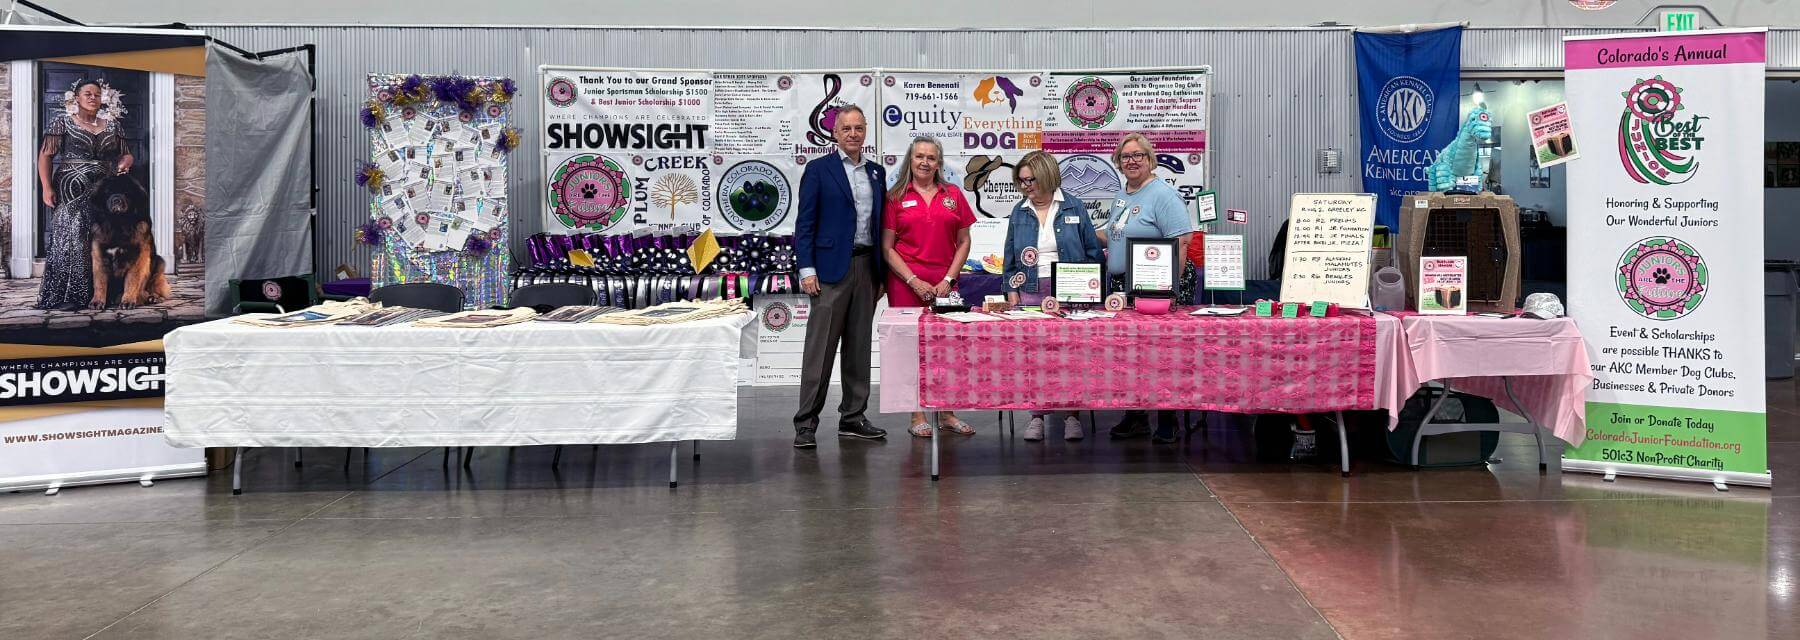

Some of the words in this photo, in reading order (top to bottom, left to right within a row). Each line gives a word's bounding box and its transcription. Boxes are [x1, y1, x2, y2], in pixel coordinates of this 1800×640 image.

[1667, 13, 1694, 31] EXIT
[1598, 46, 1668, 64] Colorado's
[1674, 44, 1726, 62] Annual
[579, 76, 604, 84] Thank
[606, 76, 622, 84] You
[652, 76, 677, 84] Grand
[680, 77, 712, 86] Sponsor
[1400, 80, 1426, 96] KENNEL
[607, 88, 643, 96] Sportsman
[645, 88, 684, 96] Scholarship
[638, 98, 676, 106] Scholarship
[1390, 88, 1422, 130] AKC
[883, 104, 962, 130] equity
[963, 116, 1042, 132] Everything
[1652, 111, 1710, 137] Best
[548, 123, 710, 149] SHOWSIGHT
[964, 132, 1016, 150] DOG
[1656, 138, 1704, 150] BEST
[1631, 119, 1670, 179] JUNIOR
[727, 166, 772, 184] COLORADO
[1366, 164, 1408, 180] KENNEL
[634, 177, 650, 225] PLUM
[644, 156, 708, 172] CREEK
[702, 170, 710, 211] COLORADO
[772, 174, 787, 204] KENNEL
[722, 185, 744, 226] SOUTHERN
[1606, 197, 1648, 210] Honoring
[1652, 197, 1660, 208] &
[1664, 198, 1718, 211] Supporting
[702, 214, 711, 226] OF
[765, 208, 782, 226] CLUB
[1606, 215, 1625, 226] Our
[1628, 215, 1678, 226] Wonderful
[1680, 216, 1718, 227] Juniors
[1639, 256, 1686, 275] JUNIORS
[1610, 326, 1638, 338] Event
[1640, 328, 1648, 338] &
[1652, 328, 1715, 343] Scholarships
[1620, 346, 1660, 357] possible
[1662, 346, 1710, 360] THANKS
[1713, 350, 1722, 360] to
[1610, 362, 1632, 374] AKC
[1636, 364, 1678, 376] Member
[1681, 366, 1701, 380] Dog
[1704, 367, 1736, 380] Clubs,
[0, 366, 166, 398] SHOWSIGH
[1592, 378, 1645, 392] Businesses
[1648, 382, 1656, 393] &
[1660, 382, 1694, 395] Private
[1698, 384, 1734, 397] Donors
[1610, 413, 1632, 424] Join
[1648, 415, 1682, 428] Donate
[1685, 418, 1714, 432] Today
[4, 426, 164, 444] WWW.SHOWSIGHTMAGAZINE.
[1586, 429, 1742, 455] ColoradoJuniorFoundation.org
[1636, 452, 1686, 464] NonProfit
[1686, 455, 1724, 471] Charity
